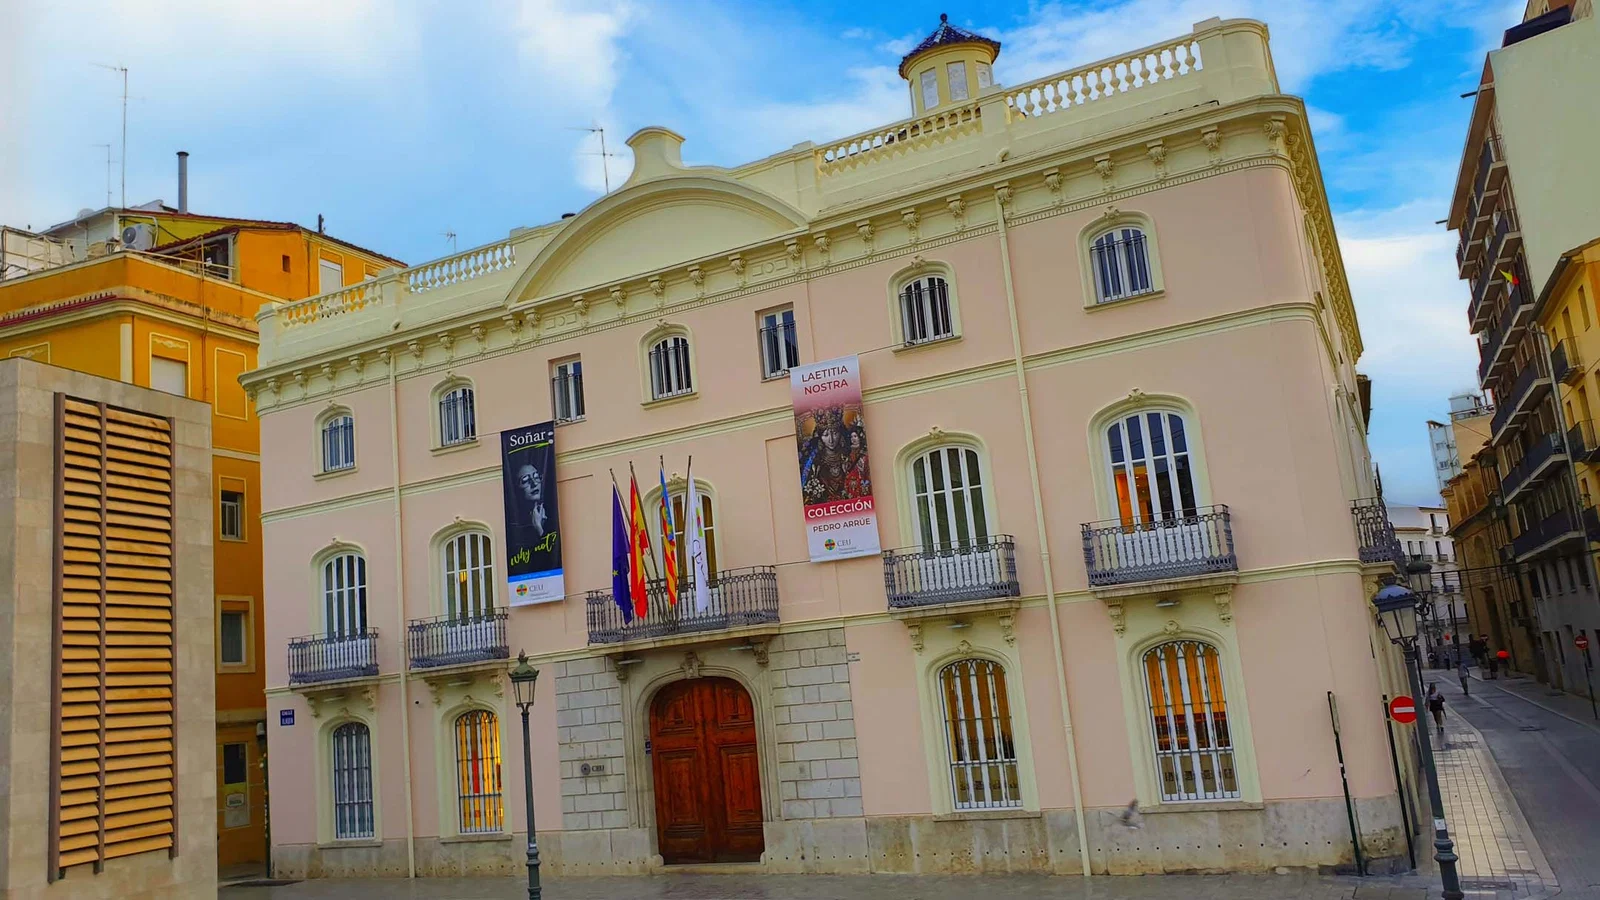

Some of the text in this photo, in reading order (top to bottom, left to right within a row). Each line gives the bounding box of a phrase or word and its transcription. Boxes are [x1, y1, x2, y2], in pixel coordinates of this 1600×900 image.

[801, 365, 849, 382] LAETITIA
[804, 379, 849, 395] NOSTRA
[807, 499, 872, 519] COLECCIÓN
[812, 517, 871, 533] PEDRO ARRÚE
[510, 546, 530, 566] why
